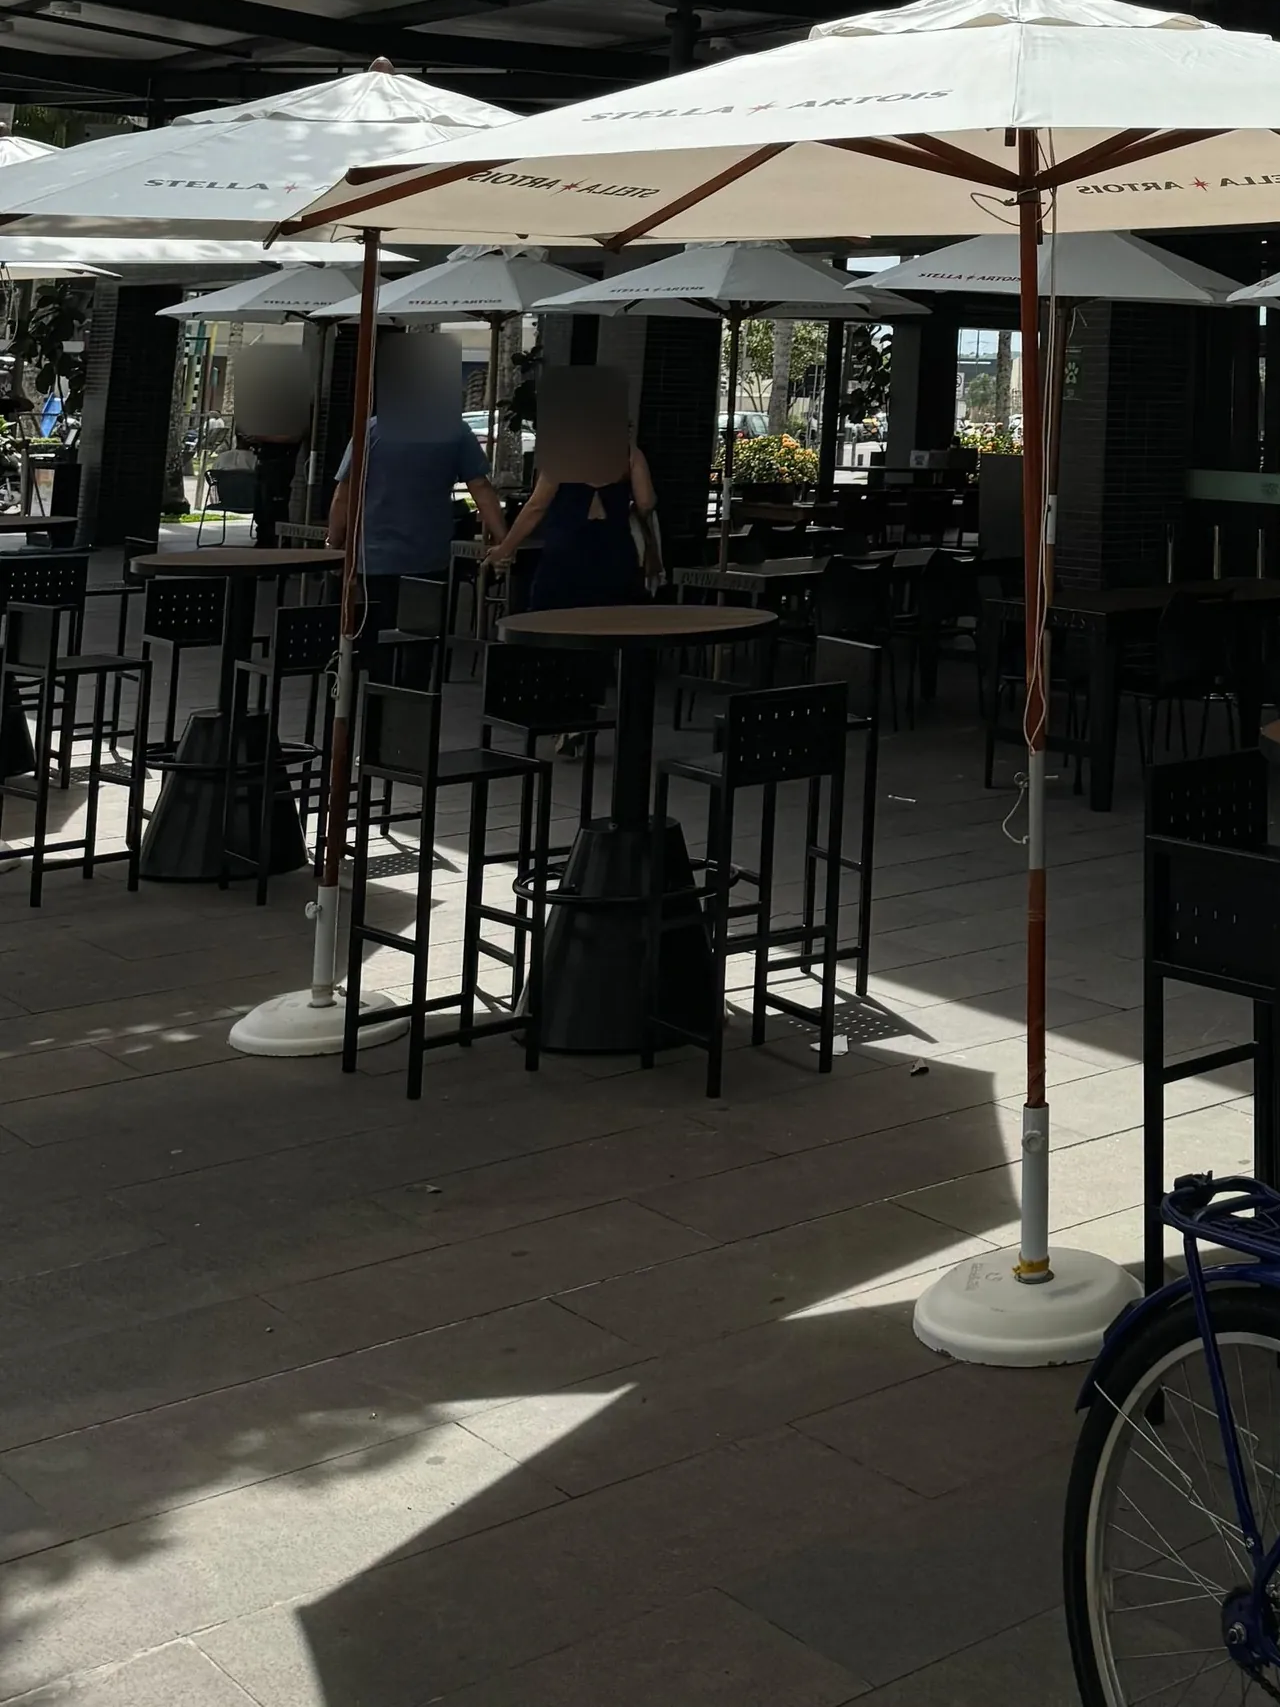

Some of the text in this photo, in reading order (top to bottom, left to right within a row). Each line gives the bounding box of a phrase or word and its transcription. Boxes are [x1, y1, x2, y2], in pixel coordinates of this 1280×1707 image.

[582, 88, 954, 122] STELLA ARTOIS
[144, 179, 270, 191] STELLA
